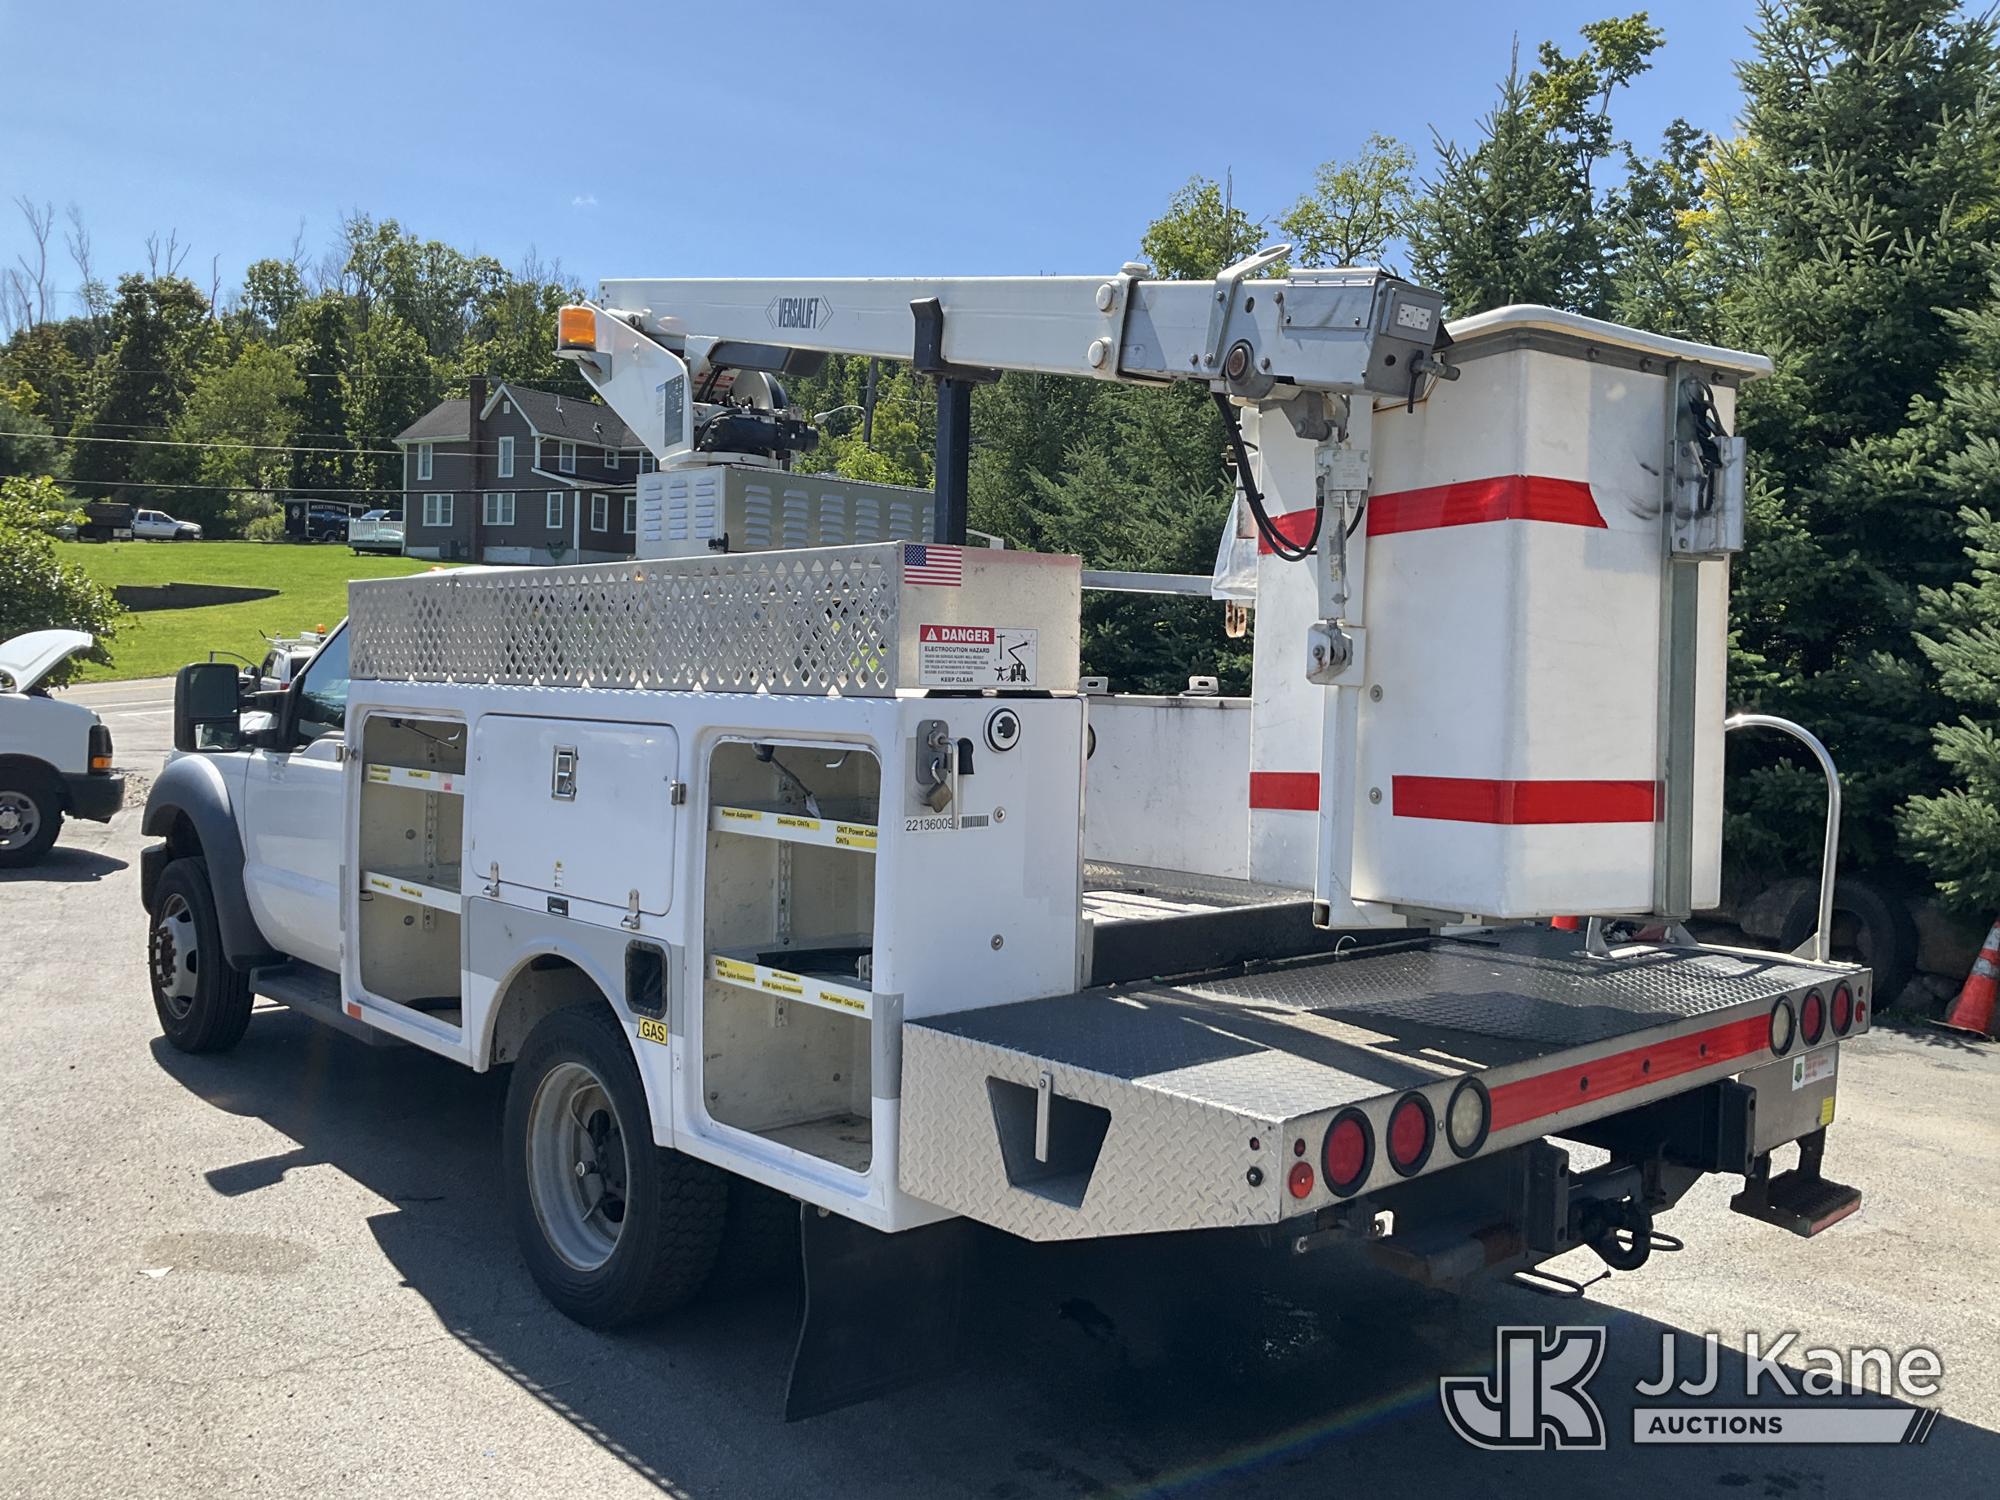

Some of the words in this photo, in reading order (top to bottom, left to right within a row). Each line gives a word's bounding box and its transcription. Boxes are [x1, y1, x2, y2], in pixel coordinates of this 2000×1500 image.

[778, 298, 819, 329] VERSALIFT
[941, 628, 990, 642] DANGER
[905, 816, 958, 832] 22136009
[642, 1021, 665, 1042] GAS
